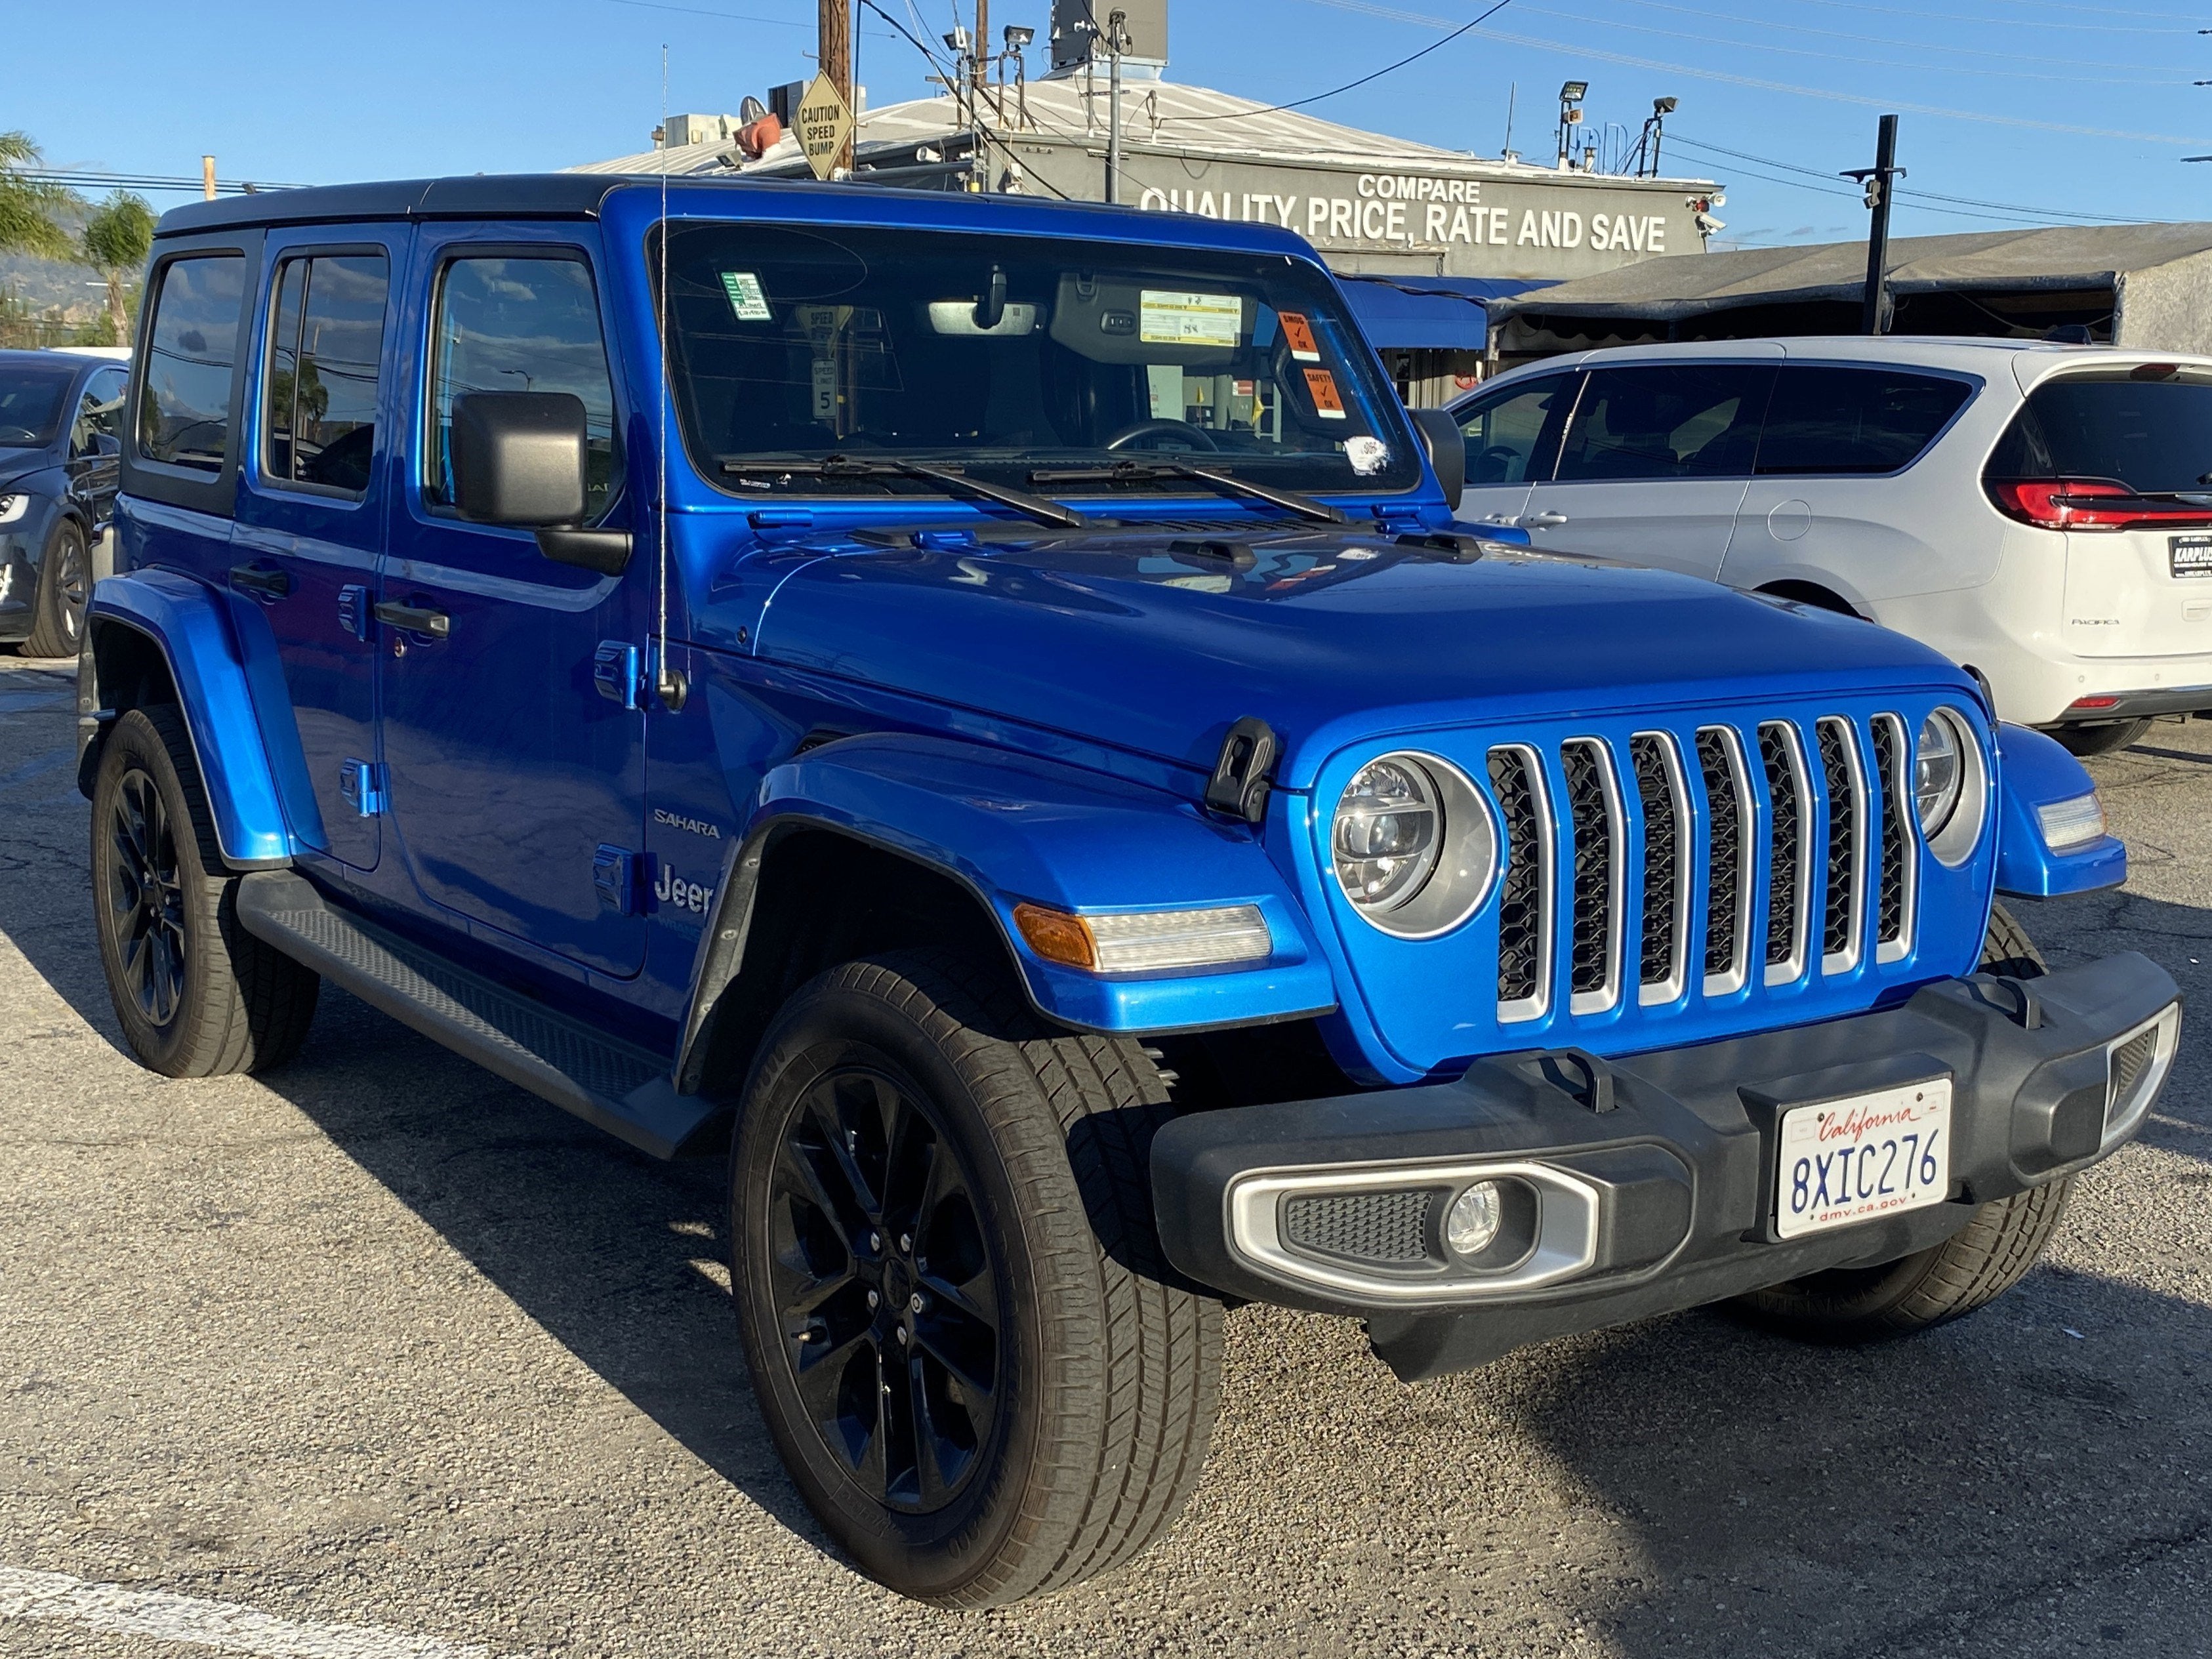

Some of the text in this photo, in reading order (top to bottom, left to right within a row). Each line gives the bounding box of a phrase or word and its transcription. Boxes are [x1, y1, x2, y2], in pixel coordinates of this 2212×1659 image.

[802, 104, 840, 124] CAUTION
[807, 125, 835, 140] SPEED
[809, 141, 834, 156] BUMP
[1357, 174, 1481, 203] COMPARE
[1308, 197, 1414, 249] PRICE,
[1425, 203, 1509, 245] RATE
[1517, 209, 1583, 249] AND
[1590, 213, 1666, 253] SAVE
[1282, 314, 1305, 325] SMOG
[1298, 340, 1308, 349] OK
[1307, 373, 1332, 383] SAFETY
[820, 392, 831, 410] 5
[1323, 399, 1334, 409] OK
[654, 808, 721, 839] SAHARA
[1819, 1106, 1921, 1143] California
[1792, 1128, 1939, 1214] 8XIC276
[1819, 1196, 1907, 1221] dmv.ca.gov
